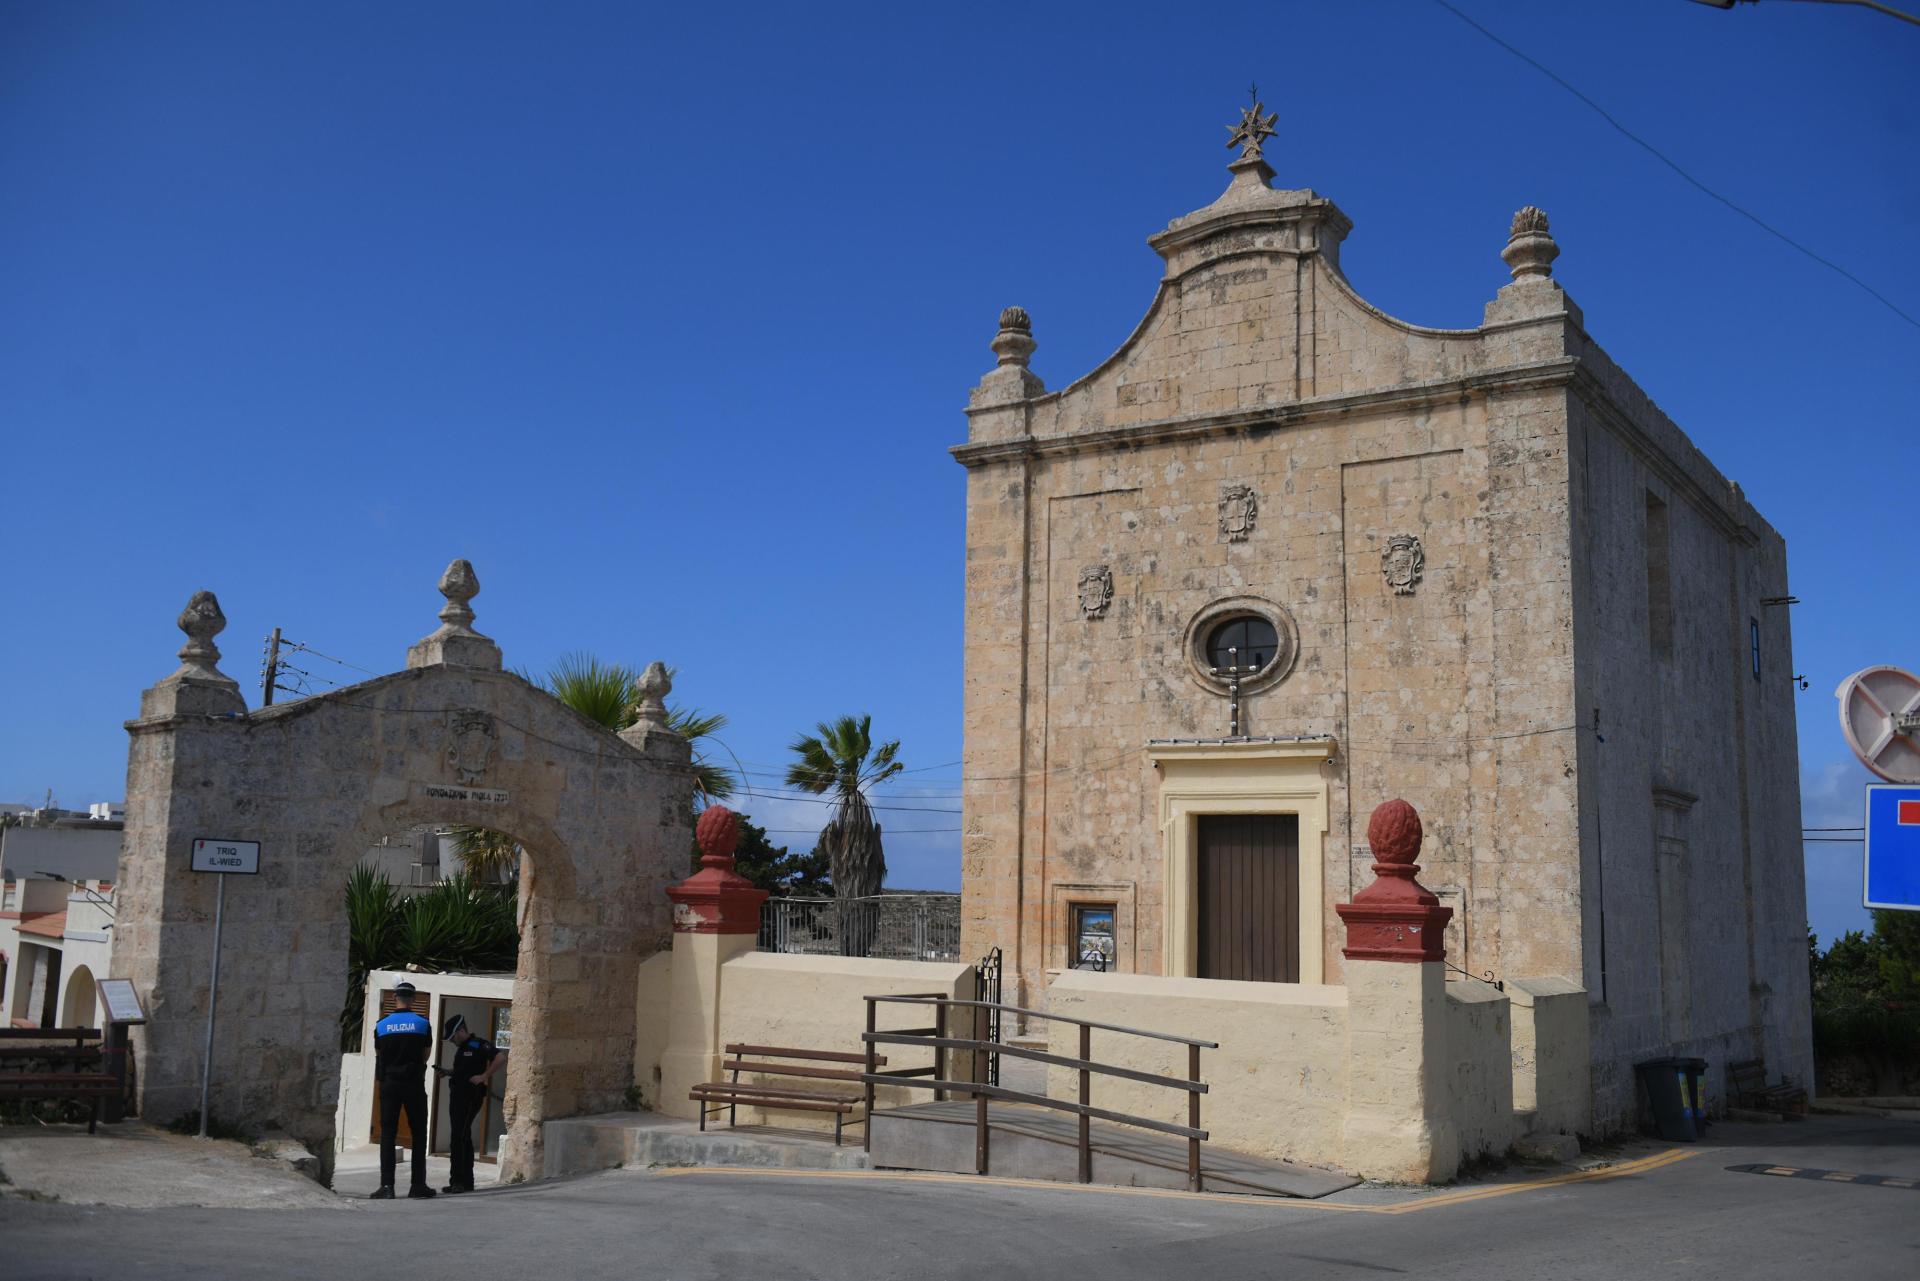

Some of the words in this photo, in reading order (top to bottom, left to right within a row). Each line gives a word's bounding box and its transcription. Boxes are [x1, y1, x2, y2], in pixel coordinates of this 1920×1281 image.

[216, 847, 238, 856] TRIQ
[209, 857, 242, 867] IL-WIED
[386, 1023, 416, 1032] PULIZIJA
